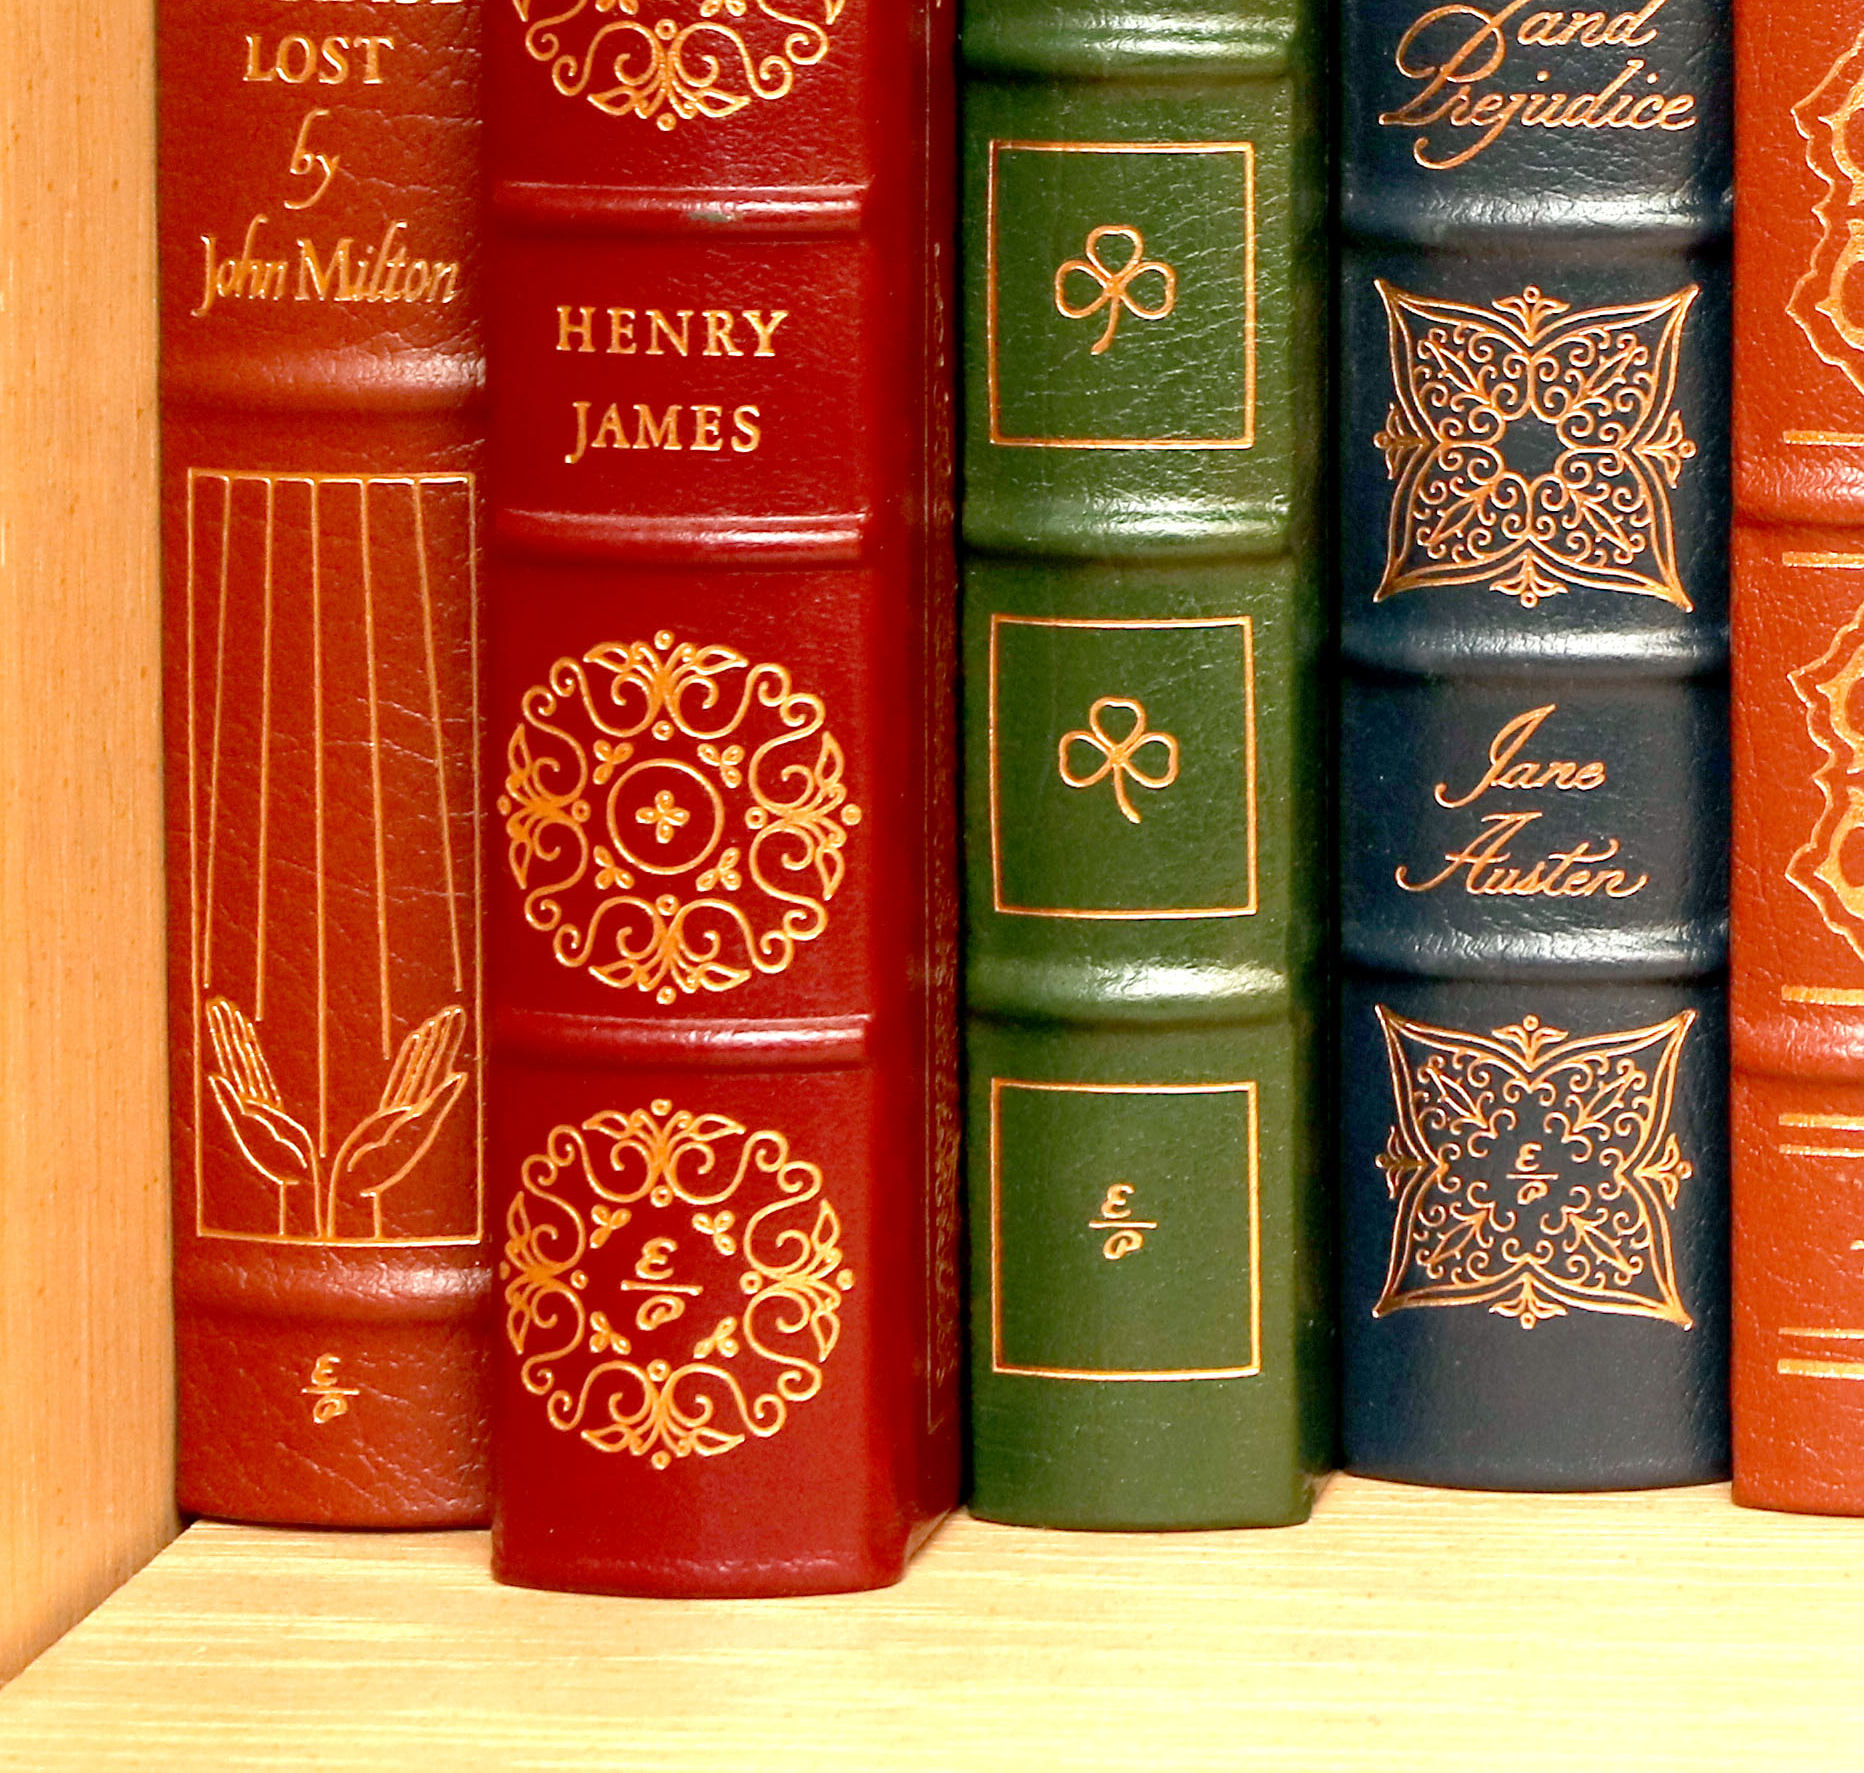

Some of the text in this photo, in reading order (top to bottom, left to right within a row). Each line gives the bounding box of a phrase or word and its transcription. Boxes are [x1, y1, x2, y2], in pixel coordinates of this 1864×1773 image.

[244, 36, 393, 85] LOST
[284, 109, 340, 209] by
[191, 215, 461, 317] John Milton
[554, 306, 788, 358] HENRY
[566, 402, 763, 463] JAMES
[1434, 704, 1605, 808] Jane
[1396, 812, 1649, 899] Austen
